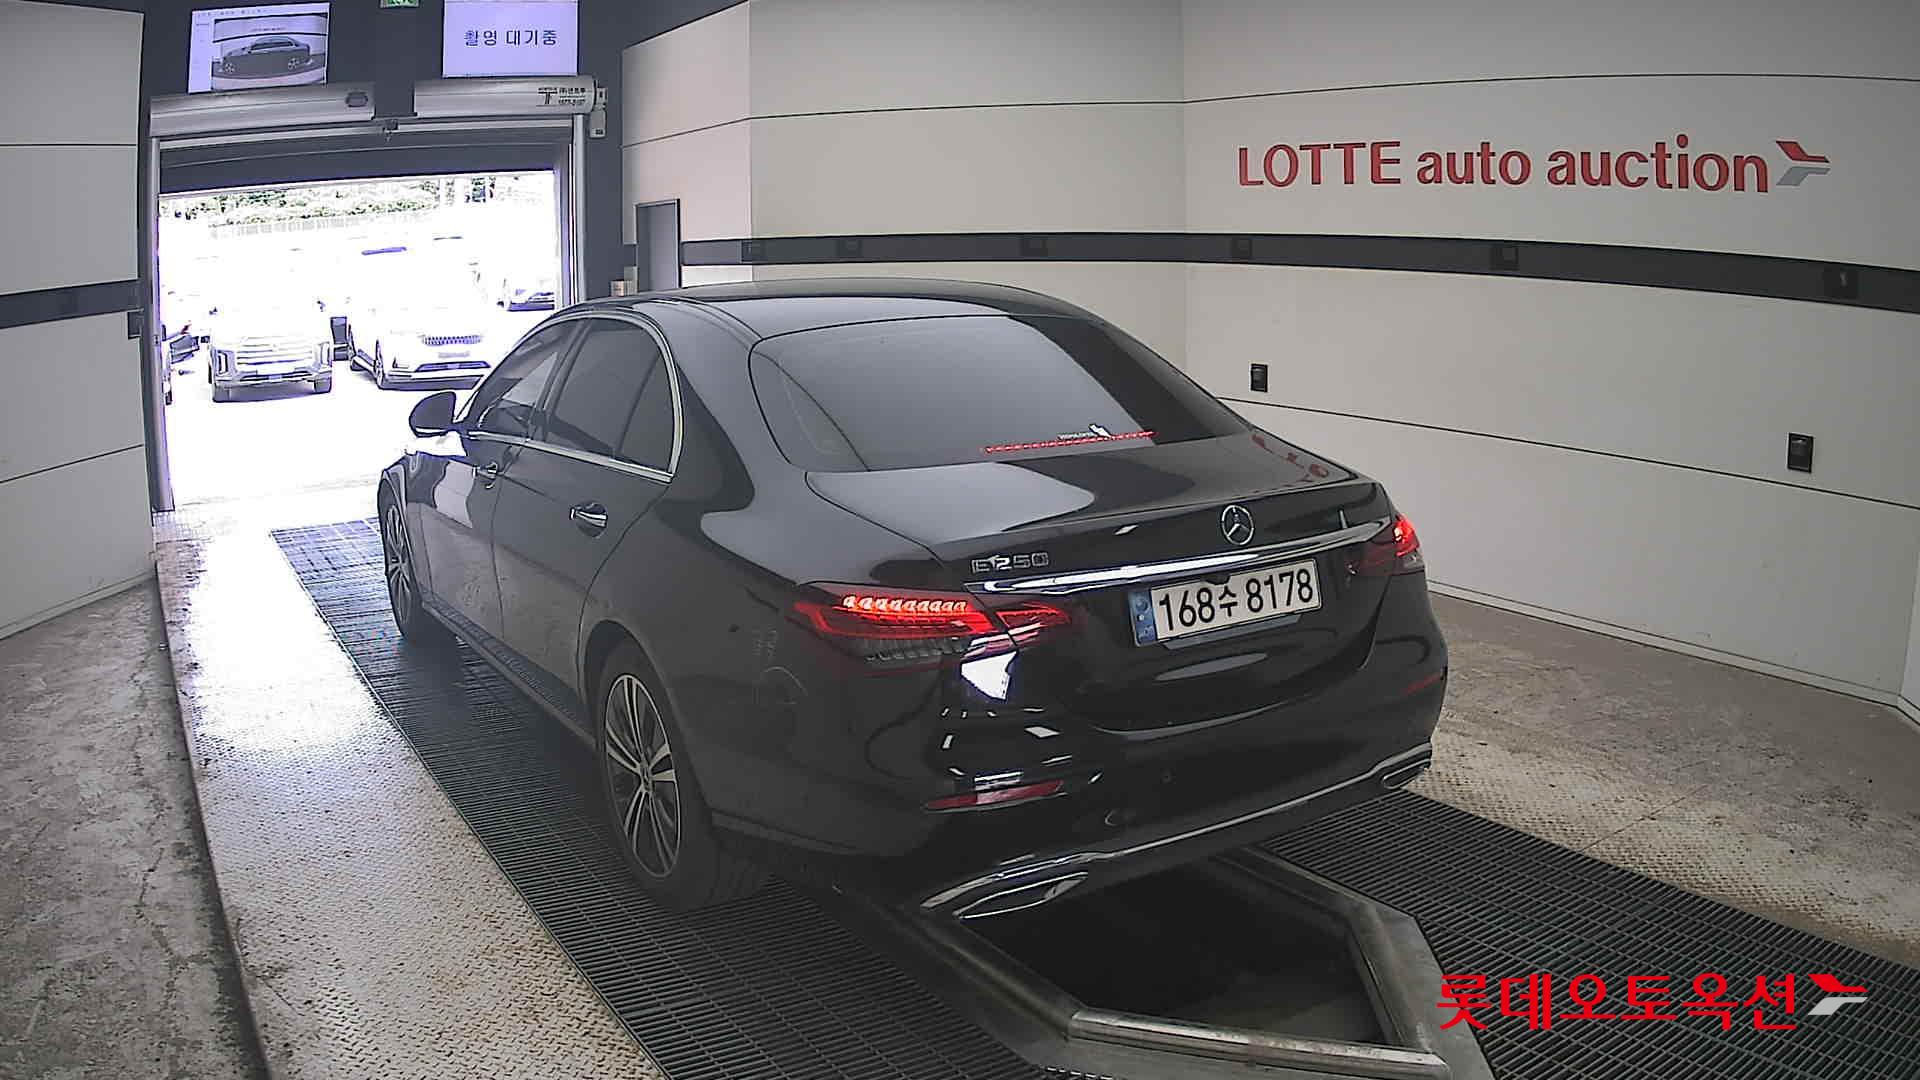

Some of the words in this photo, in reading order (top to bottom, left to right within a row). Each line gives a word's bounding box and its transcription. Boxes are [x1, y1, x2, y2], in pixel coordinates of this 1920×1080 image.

[506, 29, 557, 46] 대기중
[1238, 141, 1401, 187] LOTTE
[1416, 141, 1532, 185] auto
[1547, 134, 1768, 193] auction
